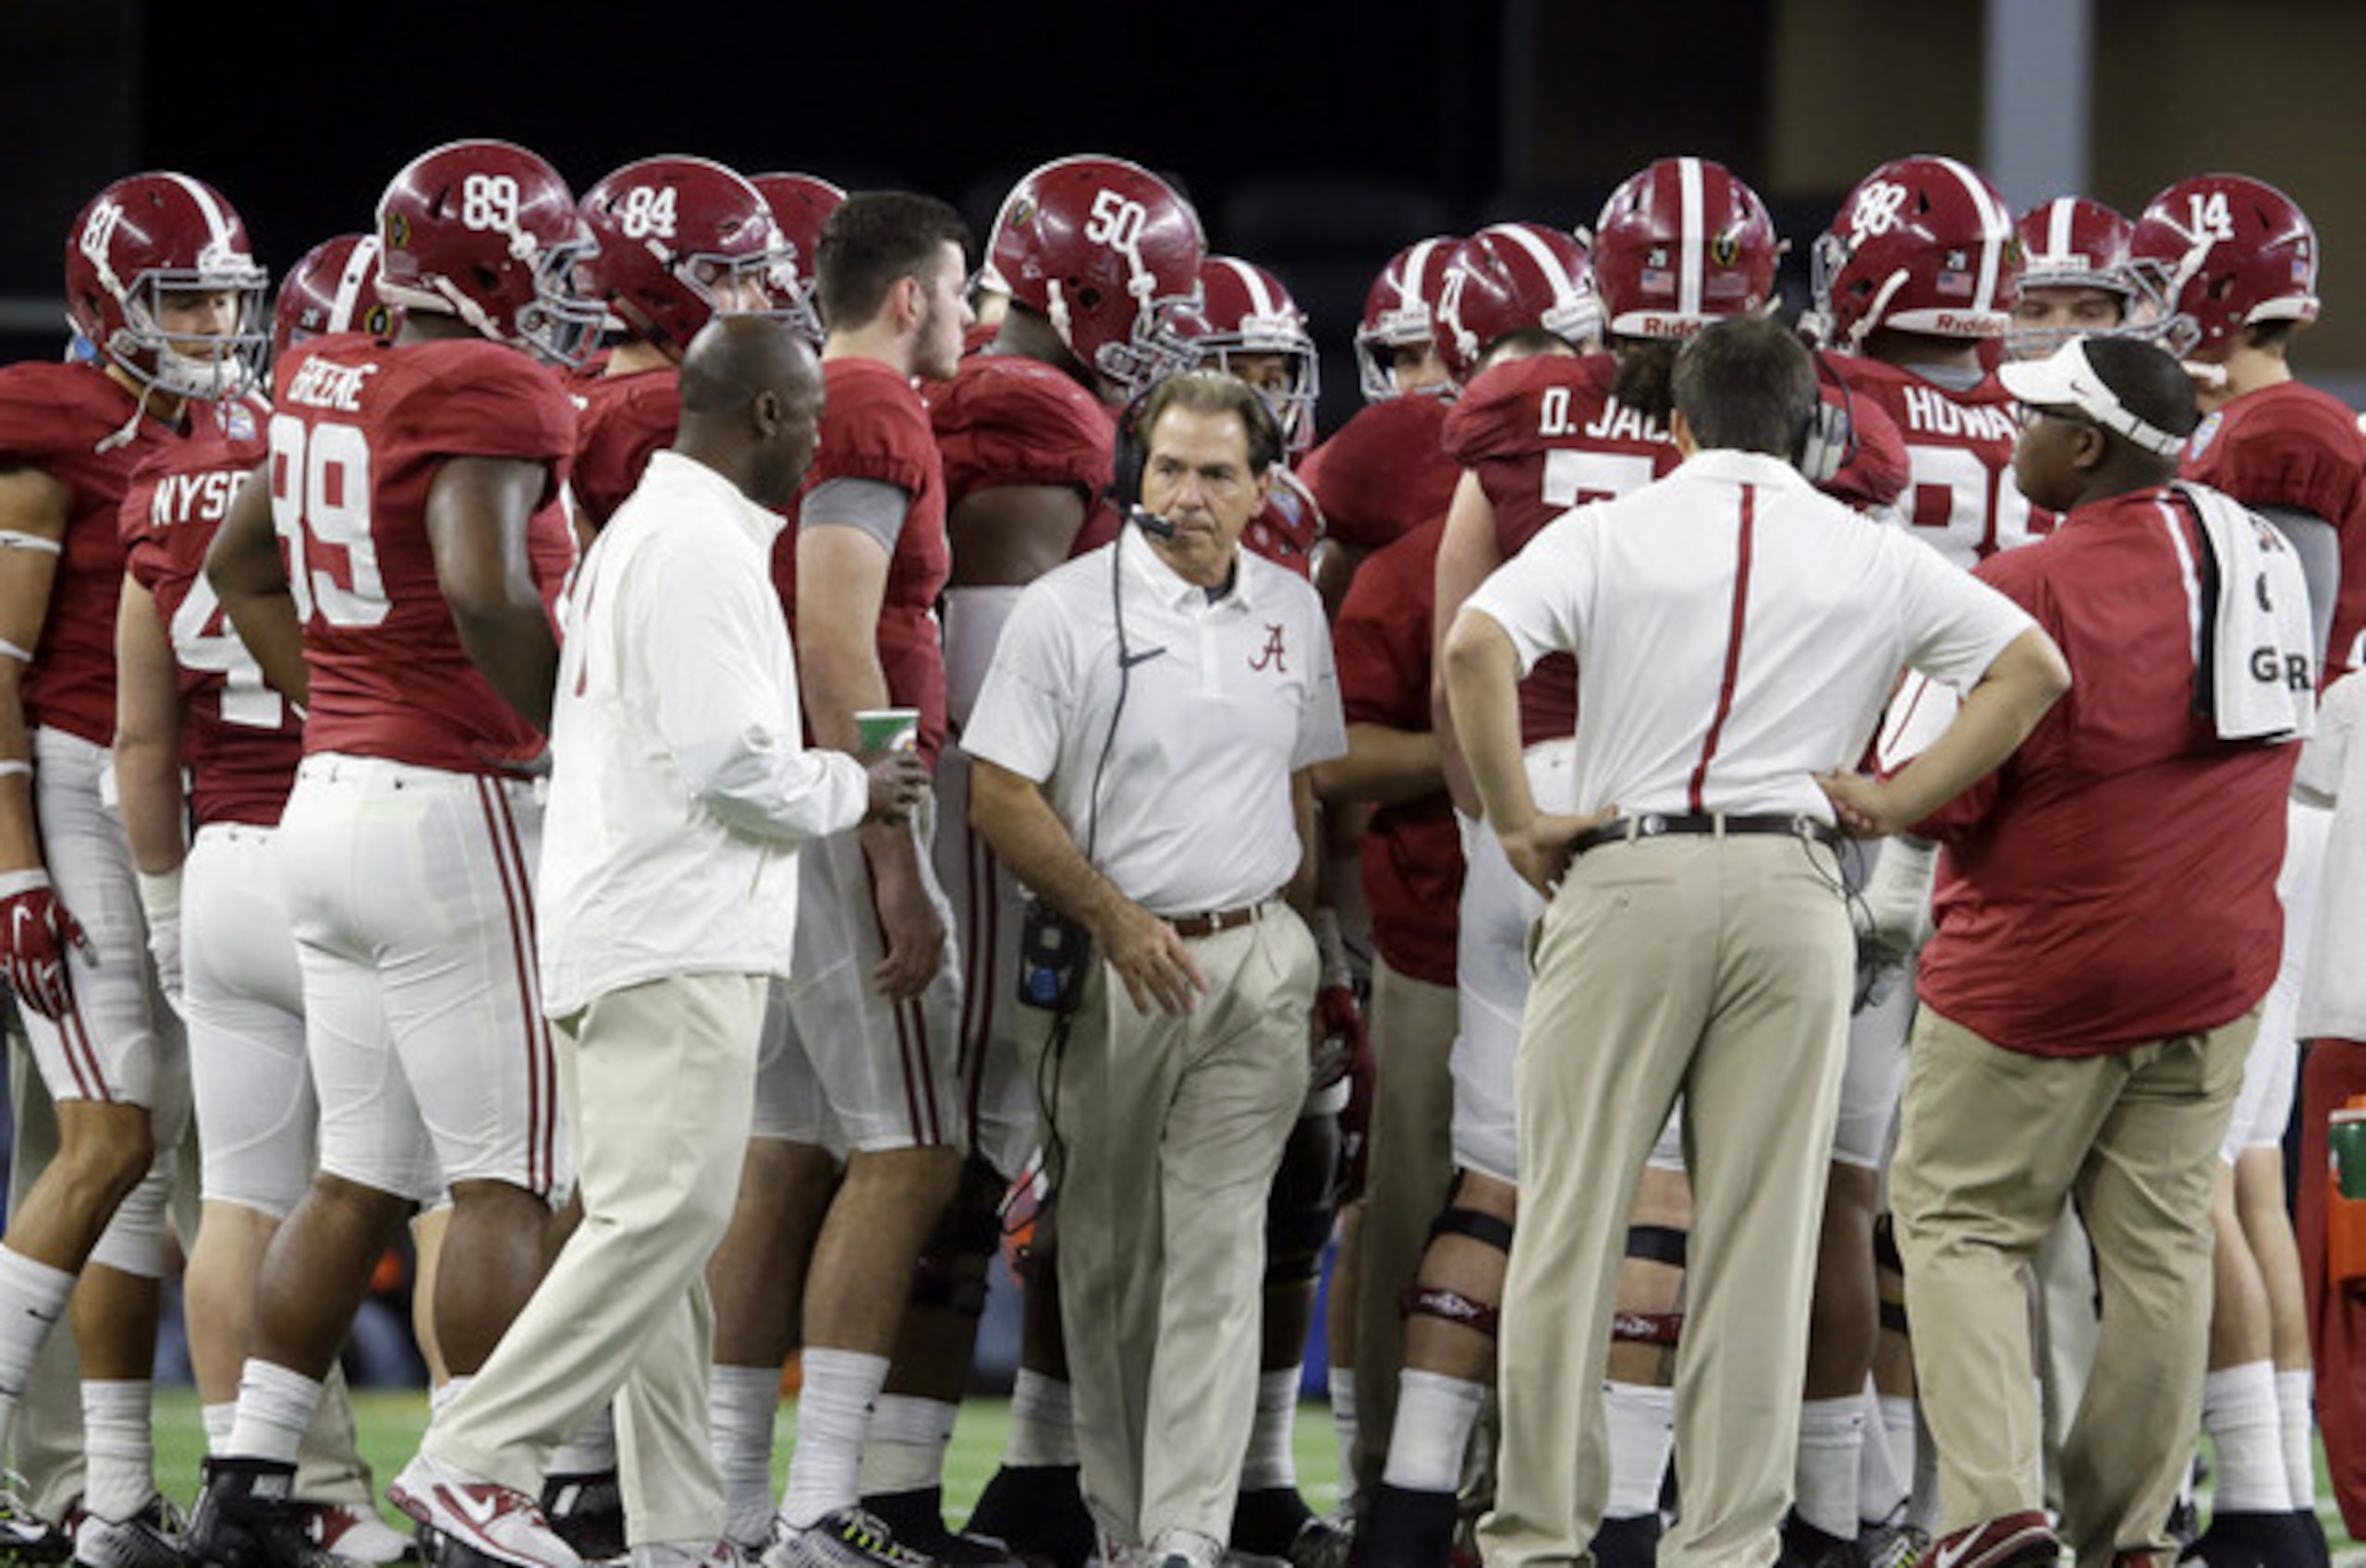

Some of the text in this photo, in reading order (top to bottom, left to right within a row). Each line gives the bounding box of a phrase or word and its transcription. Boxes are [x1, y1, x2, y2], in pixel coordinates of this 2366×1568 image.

[463, 174, 518, 233] 89
[623, 186, 677, 238] 84
[1083, 188, 1146, 254] 50
[1851, 180, 1907, 236] 88
[2188, 190, 2235, 241] 14
[1903, 385, 2020, 441] HOWA
[1248, 623, 1287, 674] A
